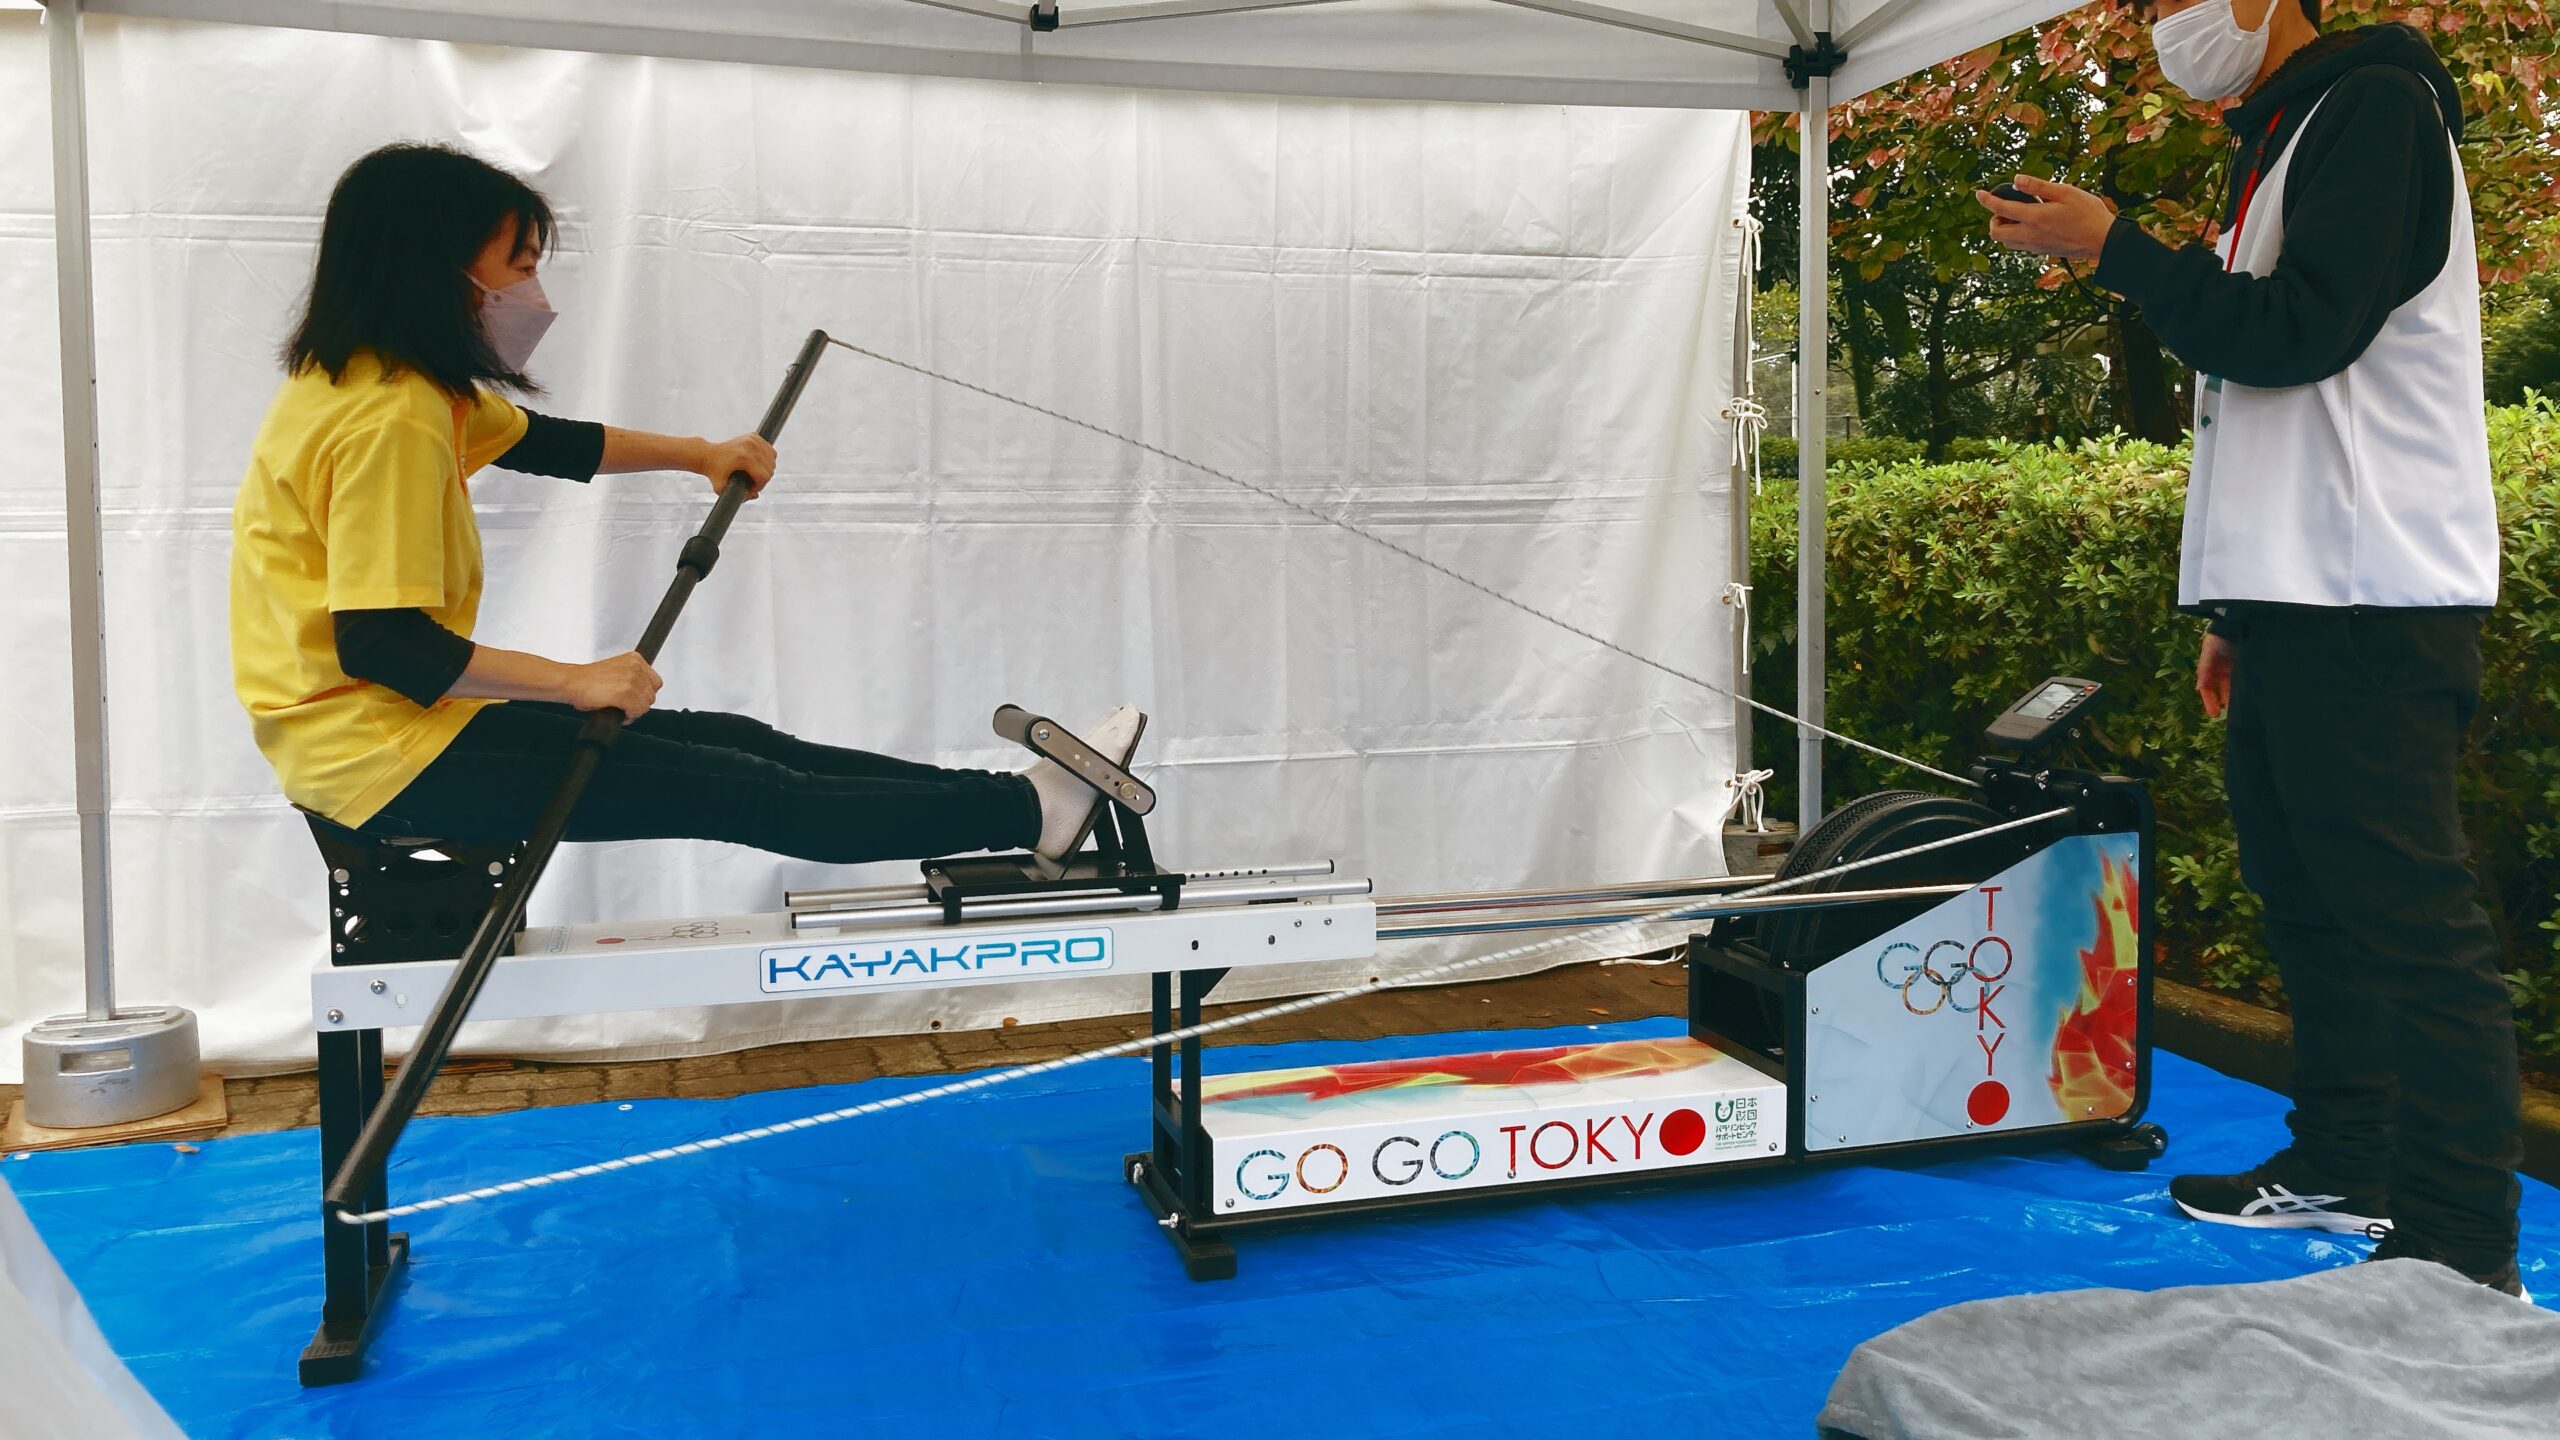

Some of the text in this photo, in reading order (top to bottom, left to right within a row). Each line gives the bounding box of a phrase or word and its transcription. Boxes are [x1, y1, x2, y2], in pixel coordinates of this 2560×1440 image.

[769, 936, 1105, 984] KAYAKPRO
[1236, 1143, 1348, 1200] GO
[1372, 1130, 1480, 1186] GO
